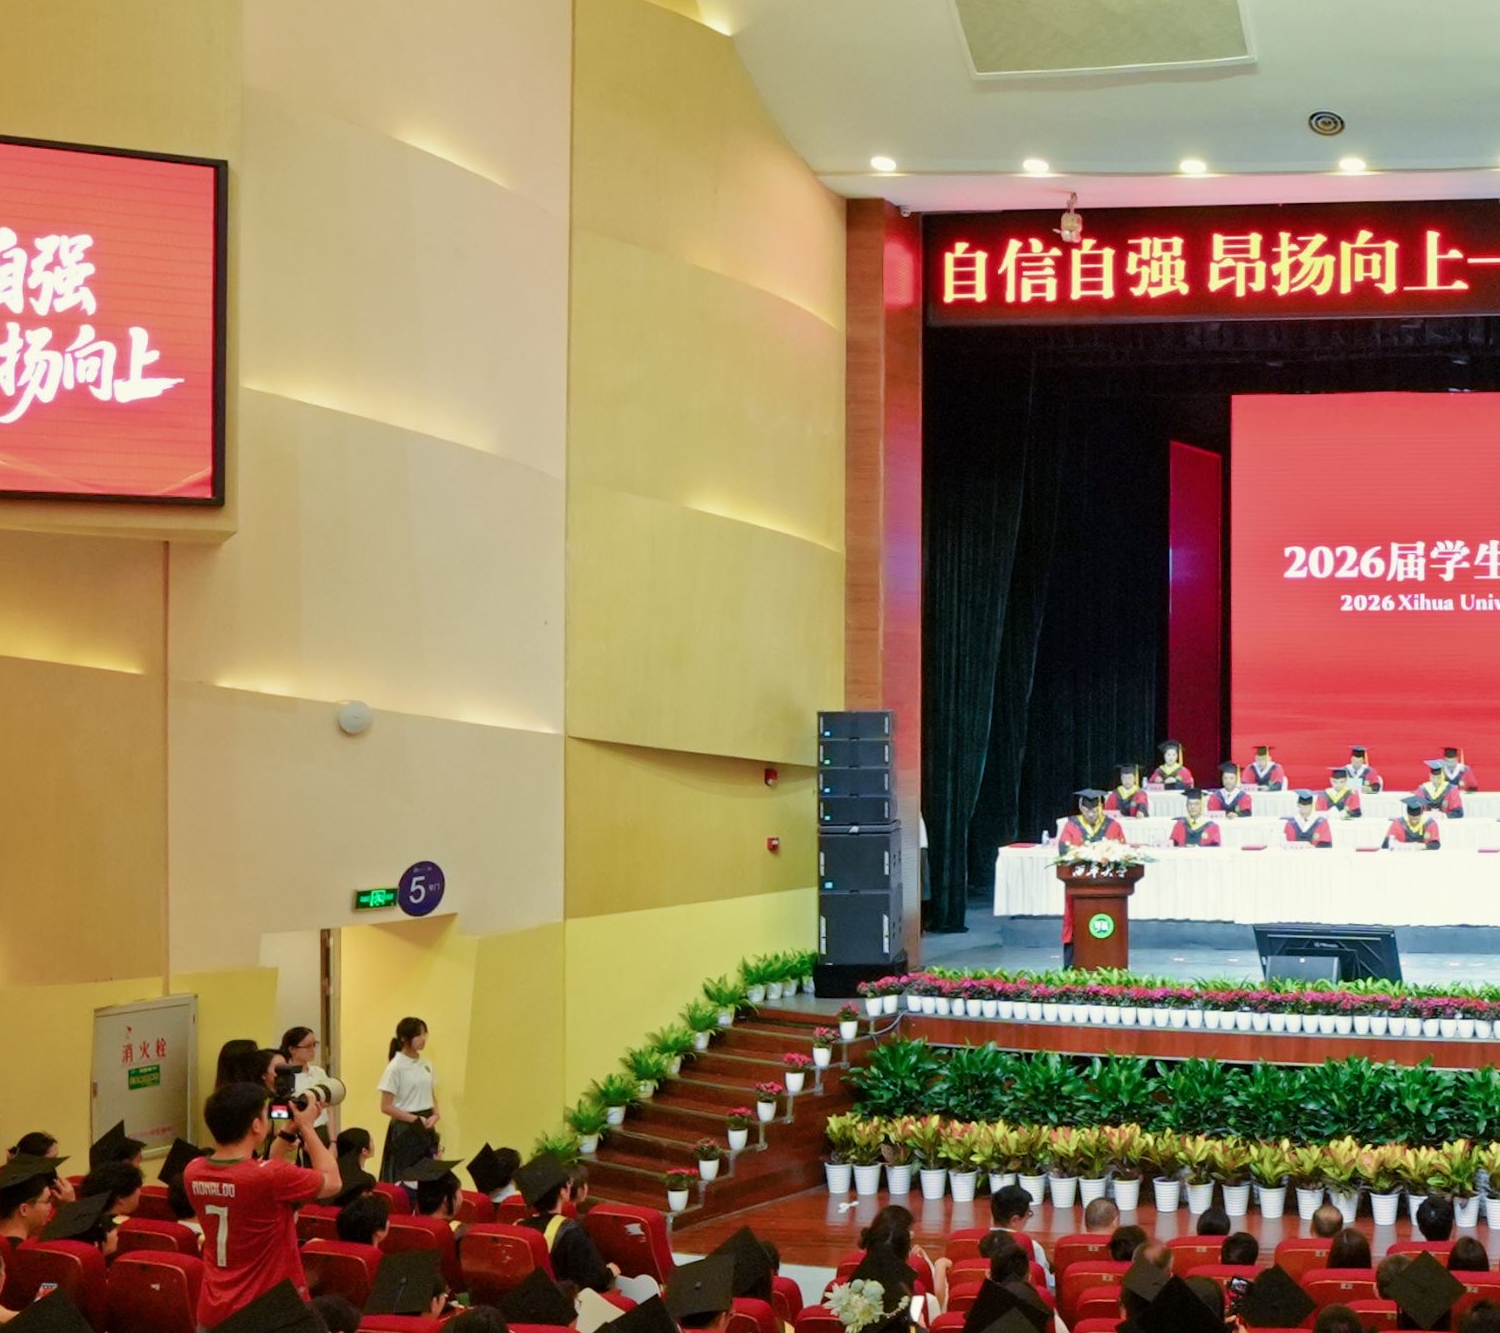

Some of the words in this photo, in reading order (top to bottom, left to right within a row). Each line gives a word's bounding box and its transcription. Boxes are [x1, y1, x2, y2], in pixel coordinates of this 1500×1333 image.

[941, 234, 1191, 304] 自信自强
[1340, 594, 1395, 612] 2026
[1398, 593, 1454, 611] Xihua
[121, 1037, 166, 1064] 消火栓
[192, 1180, 236, 1198] RONALDO
[204, 1204, 229, 1267] 7
